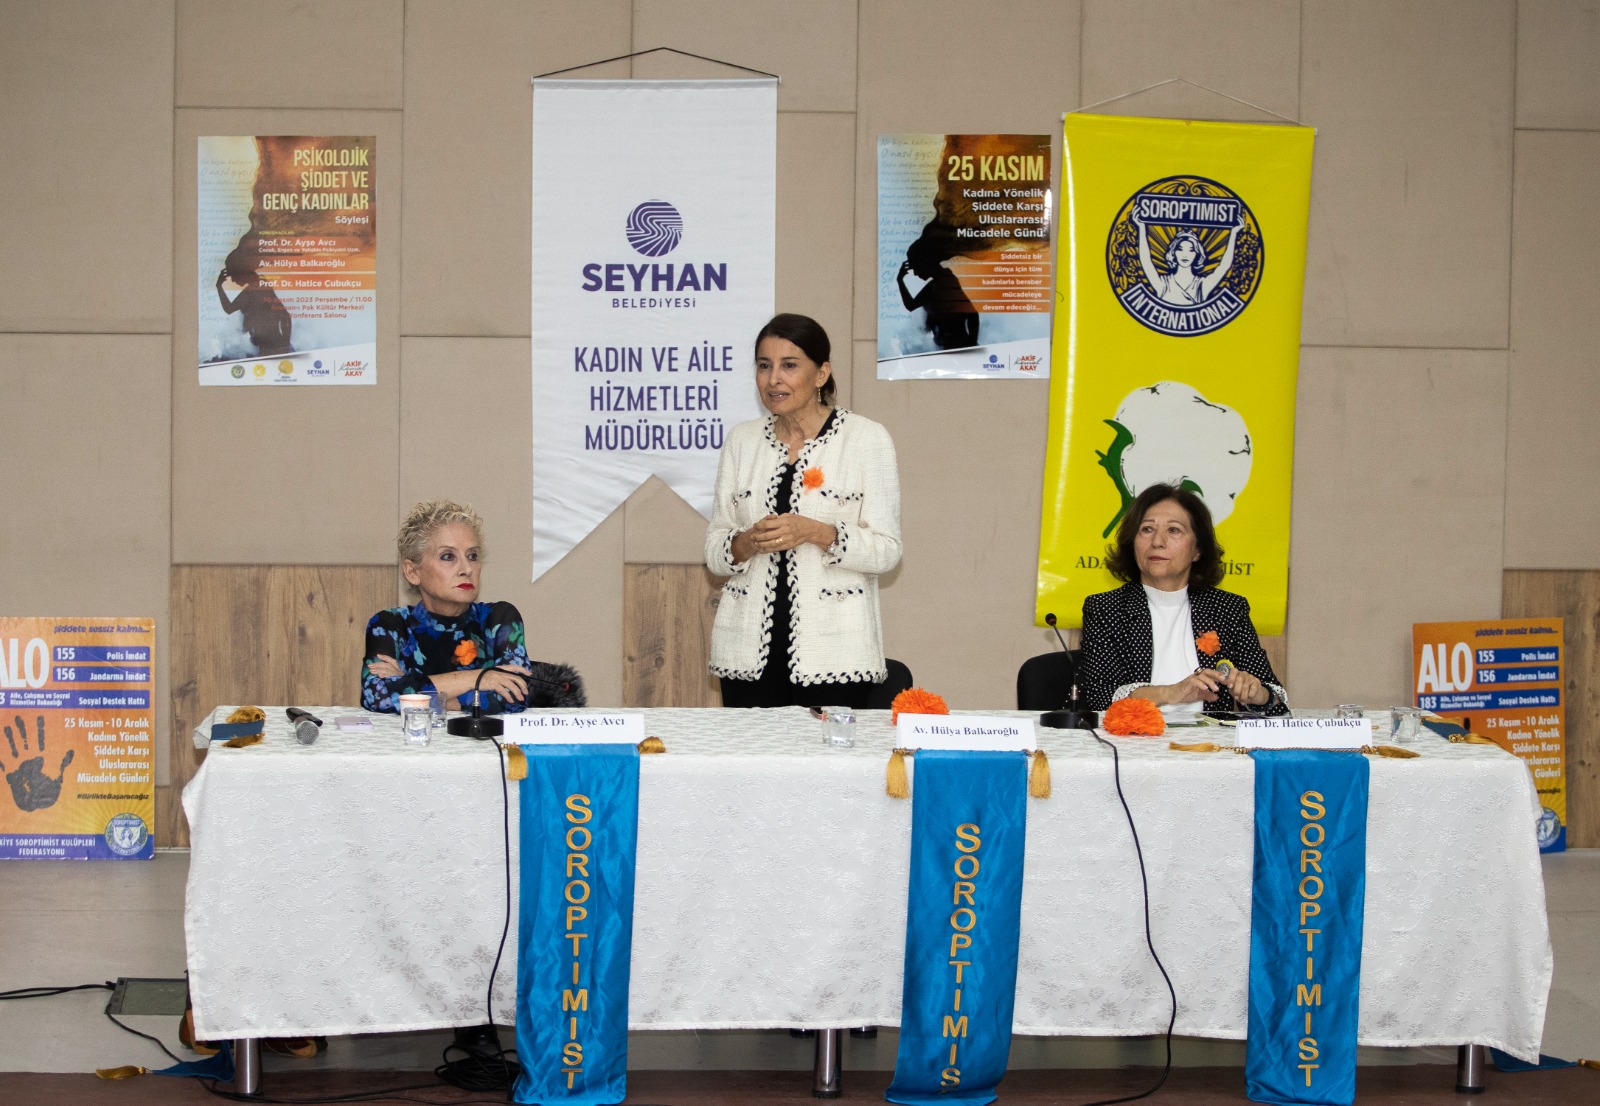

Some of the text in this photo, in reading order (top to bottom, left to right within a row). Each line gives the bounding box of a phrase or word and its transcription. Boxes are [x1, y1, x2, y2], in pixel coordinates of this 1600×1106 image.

[294, 146, 369, 167] PSİKOLOJİK
[948, 155, 1044, 181] 25 KASIM
[301, 169, 369, 191] ŞİDDET VE
[963, 188, 1043, 198] Kadına Yönelik
[263, 193, 299, 214] GENÇ
[302, 193, 369, 210] KADINLAR
[972, 202, 1043, 212] Şiddete Karşı
[1140, 199, 1237, 222] SOROPTIMIST
[335, 215, 369, 225] Söyleşi
[979, 215, 1043, 224] Uluslararası
[957, 228, 1044, 238] Mücadele Günü
[259, 239, 279, 247] Prof.
[281, 239, 292, 247] Dr.
[295, 239, 315, 248] Ayşe
[259, 259, 345, 268] Av. Hülya Balkaroğlu
[581, 262, 727, 292] SEYHAN
[324, 280, 362, 288] Çubukçu
[1002, 291, 1042, 299] mücadeleye
[1127, 288, 1239, 330] INTERNATIONAL
[574, 340, 733, 373] KADIN VE AİLE
[590, 379, 718, 412] HİZMETLERİ
[585, 418, 724, 451] MÜDÜRLÜĞÜ
[1075, 555, 1108, 569] ADA
[57, 648, 75, 660] 155
[107, 650, 146, 660] Polis İmdat
[1478, 651, 1495, 663] 155
[1521, 651, 1555, 661] Polis İmdat
[1417, 642, 1473, 693] ALO
[57, 668, 76, 681] 156
[90, 671, 146, 681] Jandarma İmdat
[1479, 670, 1496, 682] 156
[1507, 671, 1556, 681] Jandarma İmdat
[79, 697, 145, 706] Sosyal Destek Hattı
[1420, 696, 1437, 709] 183
[1499, 698, 1518, 706] Sosyal
[1519, 696, 1539, 704] Destek
[64, 718, 149, 728] 25 Kasım 10 Aralık
[520, 717, 625, 729] Prof. Dr. Ayşe Avcı
[1239, 719, 1361, 729] Prof. Dr. Hatice Çubukçu
[1486, 718, 1497, 728] 25
[1499, 717, 1521, 727] Kasım
[1526, 716, 1536, 726] 10
[912, 725, 1019, 736] Av. Hülya Balkaroğlu
[1507, 729, 1560, 740] Kadına Yönelik
[88, 731, 149, 742] Kadına Yönelik
[94, 745, 149, 757] Şiddete Karşı
[1513, 742, 1560, 754] Şiddete Karşı
[99, 759, 149, 769] Uluslararası
[77, 772, 149, 783] Mücadele Günleri
[1535, 768, 1561, 778] Günleri
[15, 837, 59, 846] SOROPTİMİST
[61, 837, 95, 846] KULÜPLERİ
[19, 848, 65, 856] FEDERASYONU
[561, 793, 593, 1090] SOROPTIMIST
[1296, 790, 1326, 1088] SOROPTIMIST
[940, 823, 982, 1095] SOROPTIMIS
